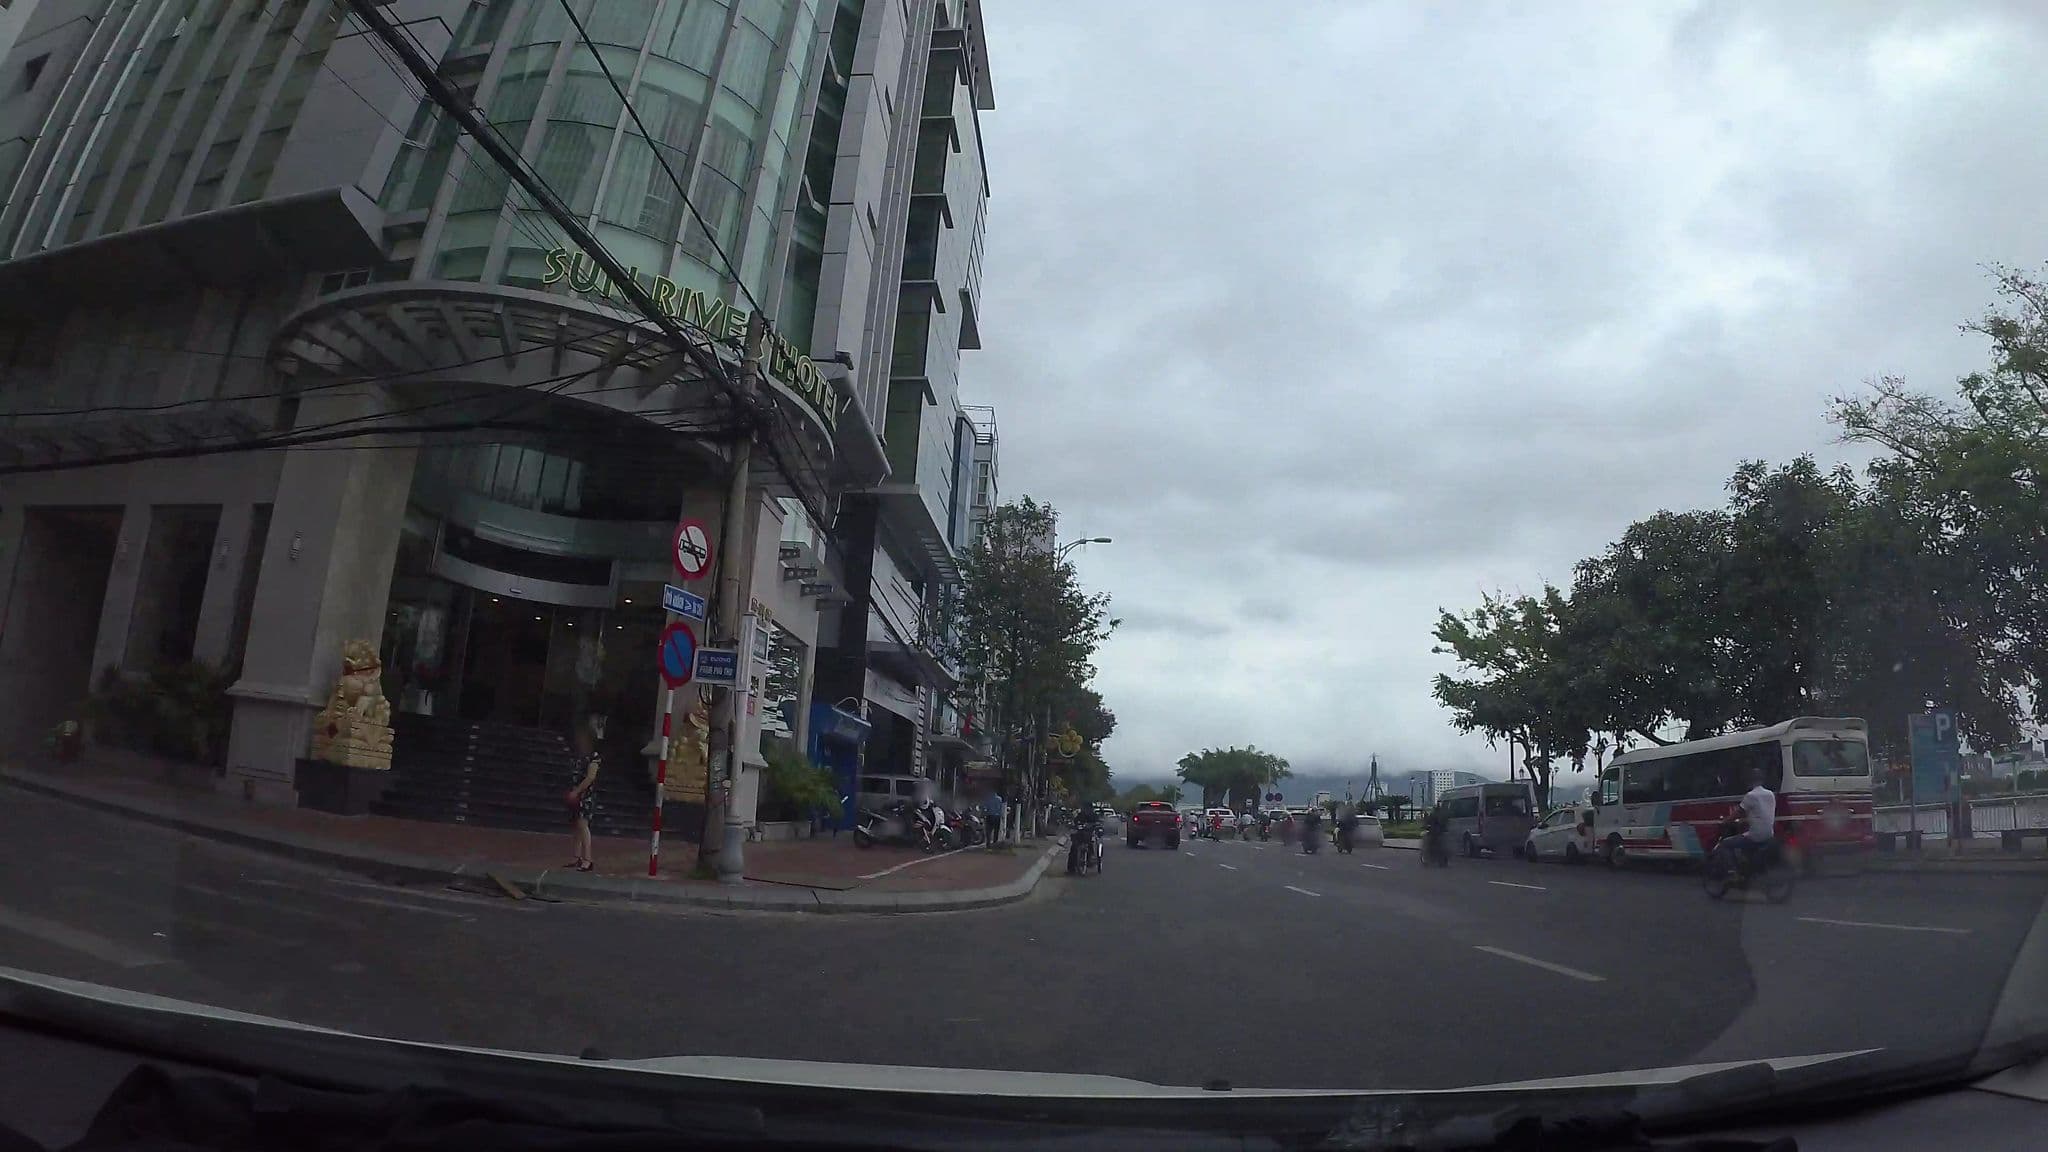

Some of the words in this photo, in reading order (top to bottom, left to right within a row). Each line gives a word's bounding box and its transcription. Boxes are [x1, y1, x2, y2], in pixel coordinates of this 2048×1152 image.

[543, 248, 639, 304] SUN
[651, 275, 765, 359] RIVE
[776, 332, 837, 432] HOTEL
[1936, 713, 1950, 741] P
